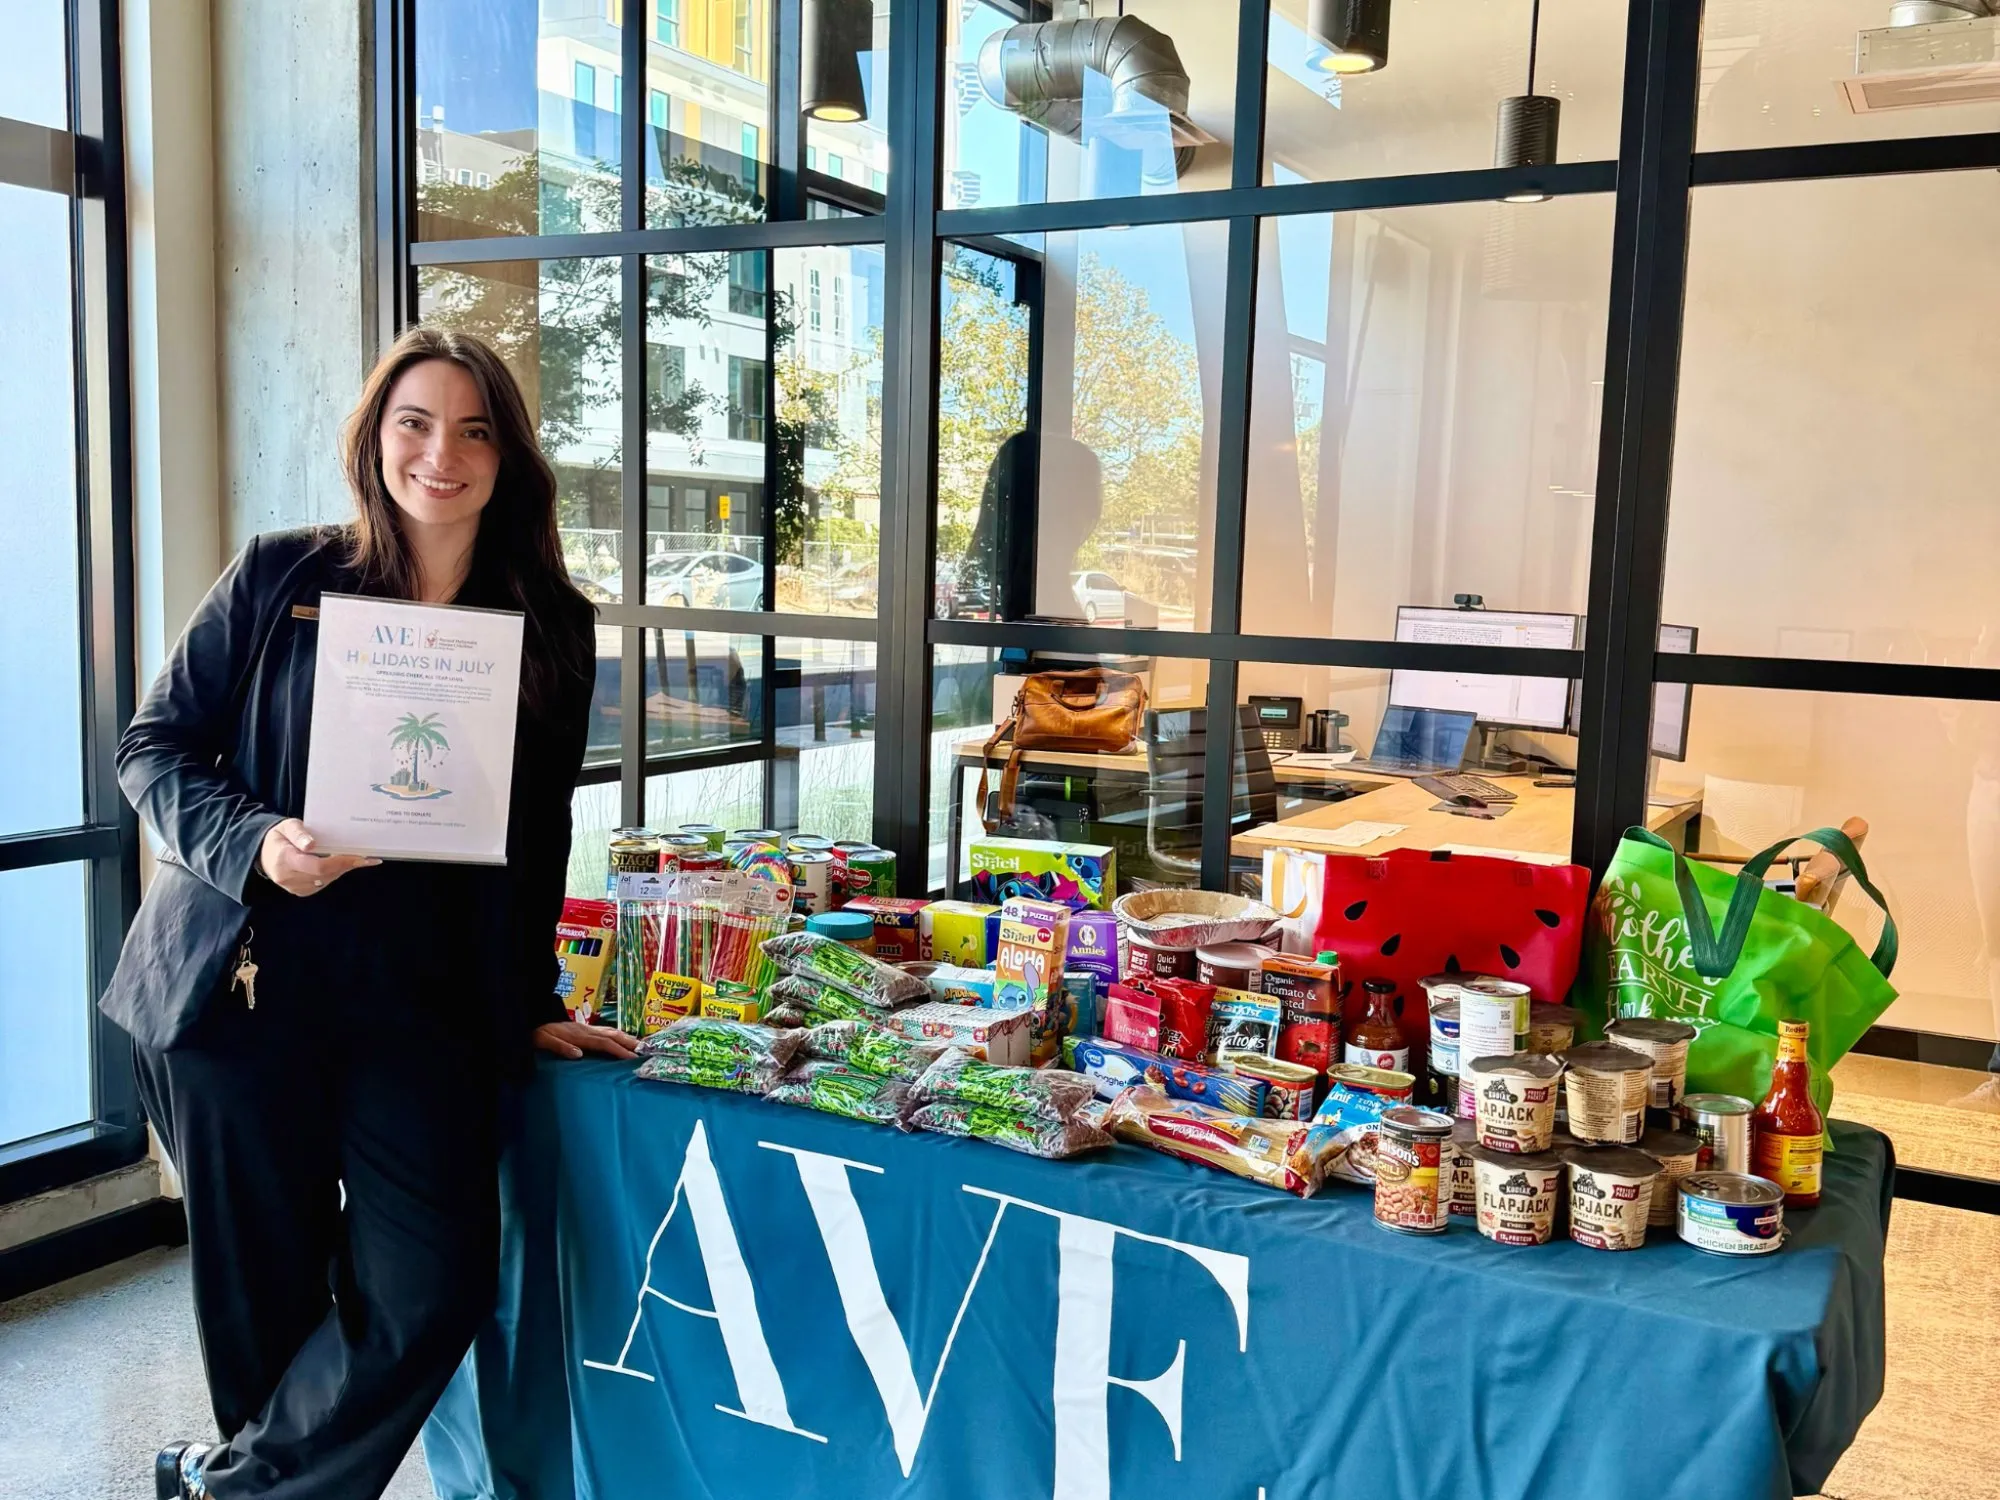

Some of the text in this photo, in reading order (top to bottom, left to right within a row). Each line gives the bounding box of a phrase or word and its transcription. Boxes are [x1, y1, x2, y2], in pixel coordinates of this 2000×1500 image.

[368, 625, 414, 647] AVE
[346, 649, 495, 675] HLIDAYS IN JULY
[611, 852, 655, 867] STAGG
[640, 887, 649, 895] 12
[747, 892, 756, 900] 12
[1004, 905, 1054, 922] 48 PUZZLE
[1071, 945, 1107, 957] Annie's
[1000, 944, 1045, 975] ALOHA
[1157, 953, 1176, 965] Quick
[1156, 962, 1172, 974] Oats
[657, 976, 690, 989] Crayola
[1265, 973, 1295, 985] Organic
[1607, 952, 1715, 1016] EARTH
[1264, 982, 1317, 1001] Tomato &
[708, 1003, 739, 1016] Crayola
[1287, 1009, 1322, 1027] Pepper
[1487, 1089, 1511, 1101] KODIAK
[1165, 1119, 1218, 1144] Spaghetti
[1492, 1140, 1515, 1149] PROTEIN
[1506, 1187, 1532, 1195] KODIAK
[1576, 1184, 1599, 1198] KODIAK
[1483, 1192, 1550, 1214] FLAPJACK
[1697, 1224, 1720, 1236] White
[1508, 1234, 1533, 1242] PROTEIN
[1579, 1234, 1601, 1245] PROTEIN
[1697, 1237, 1768, 1251] CHICKEN BREAST
